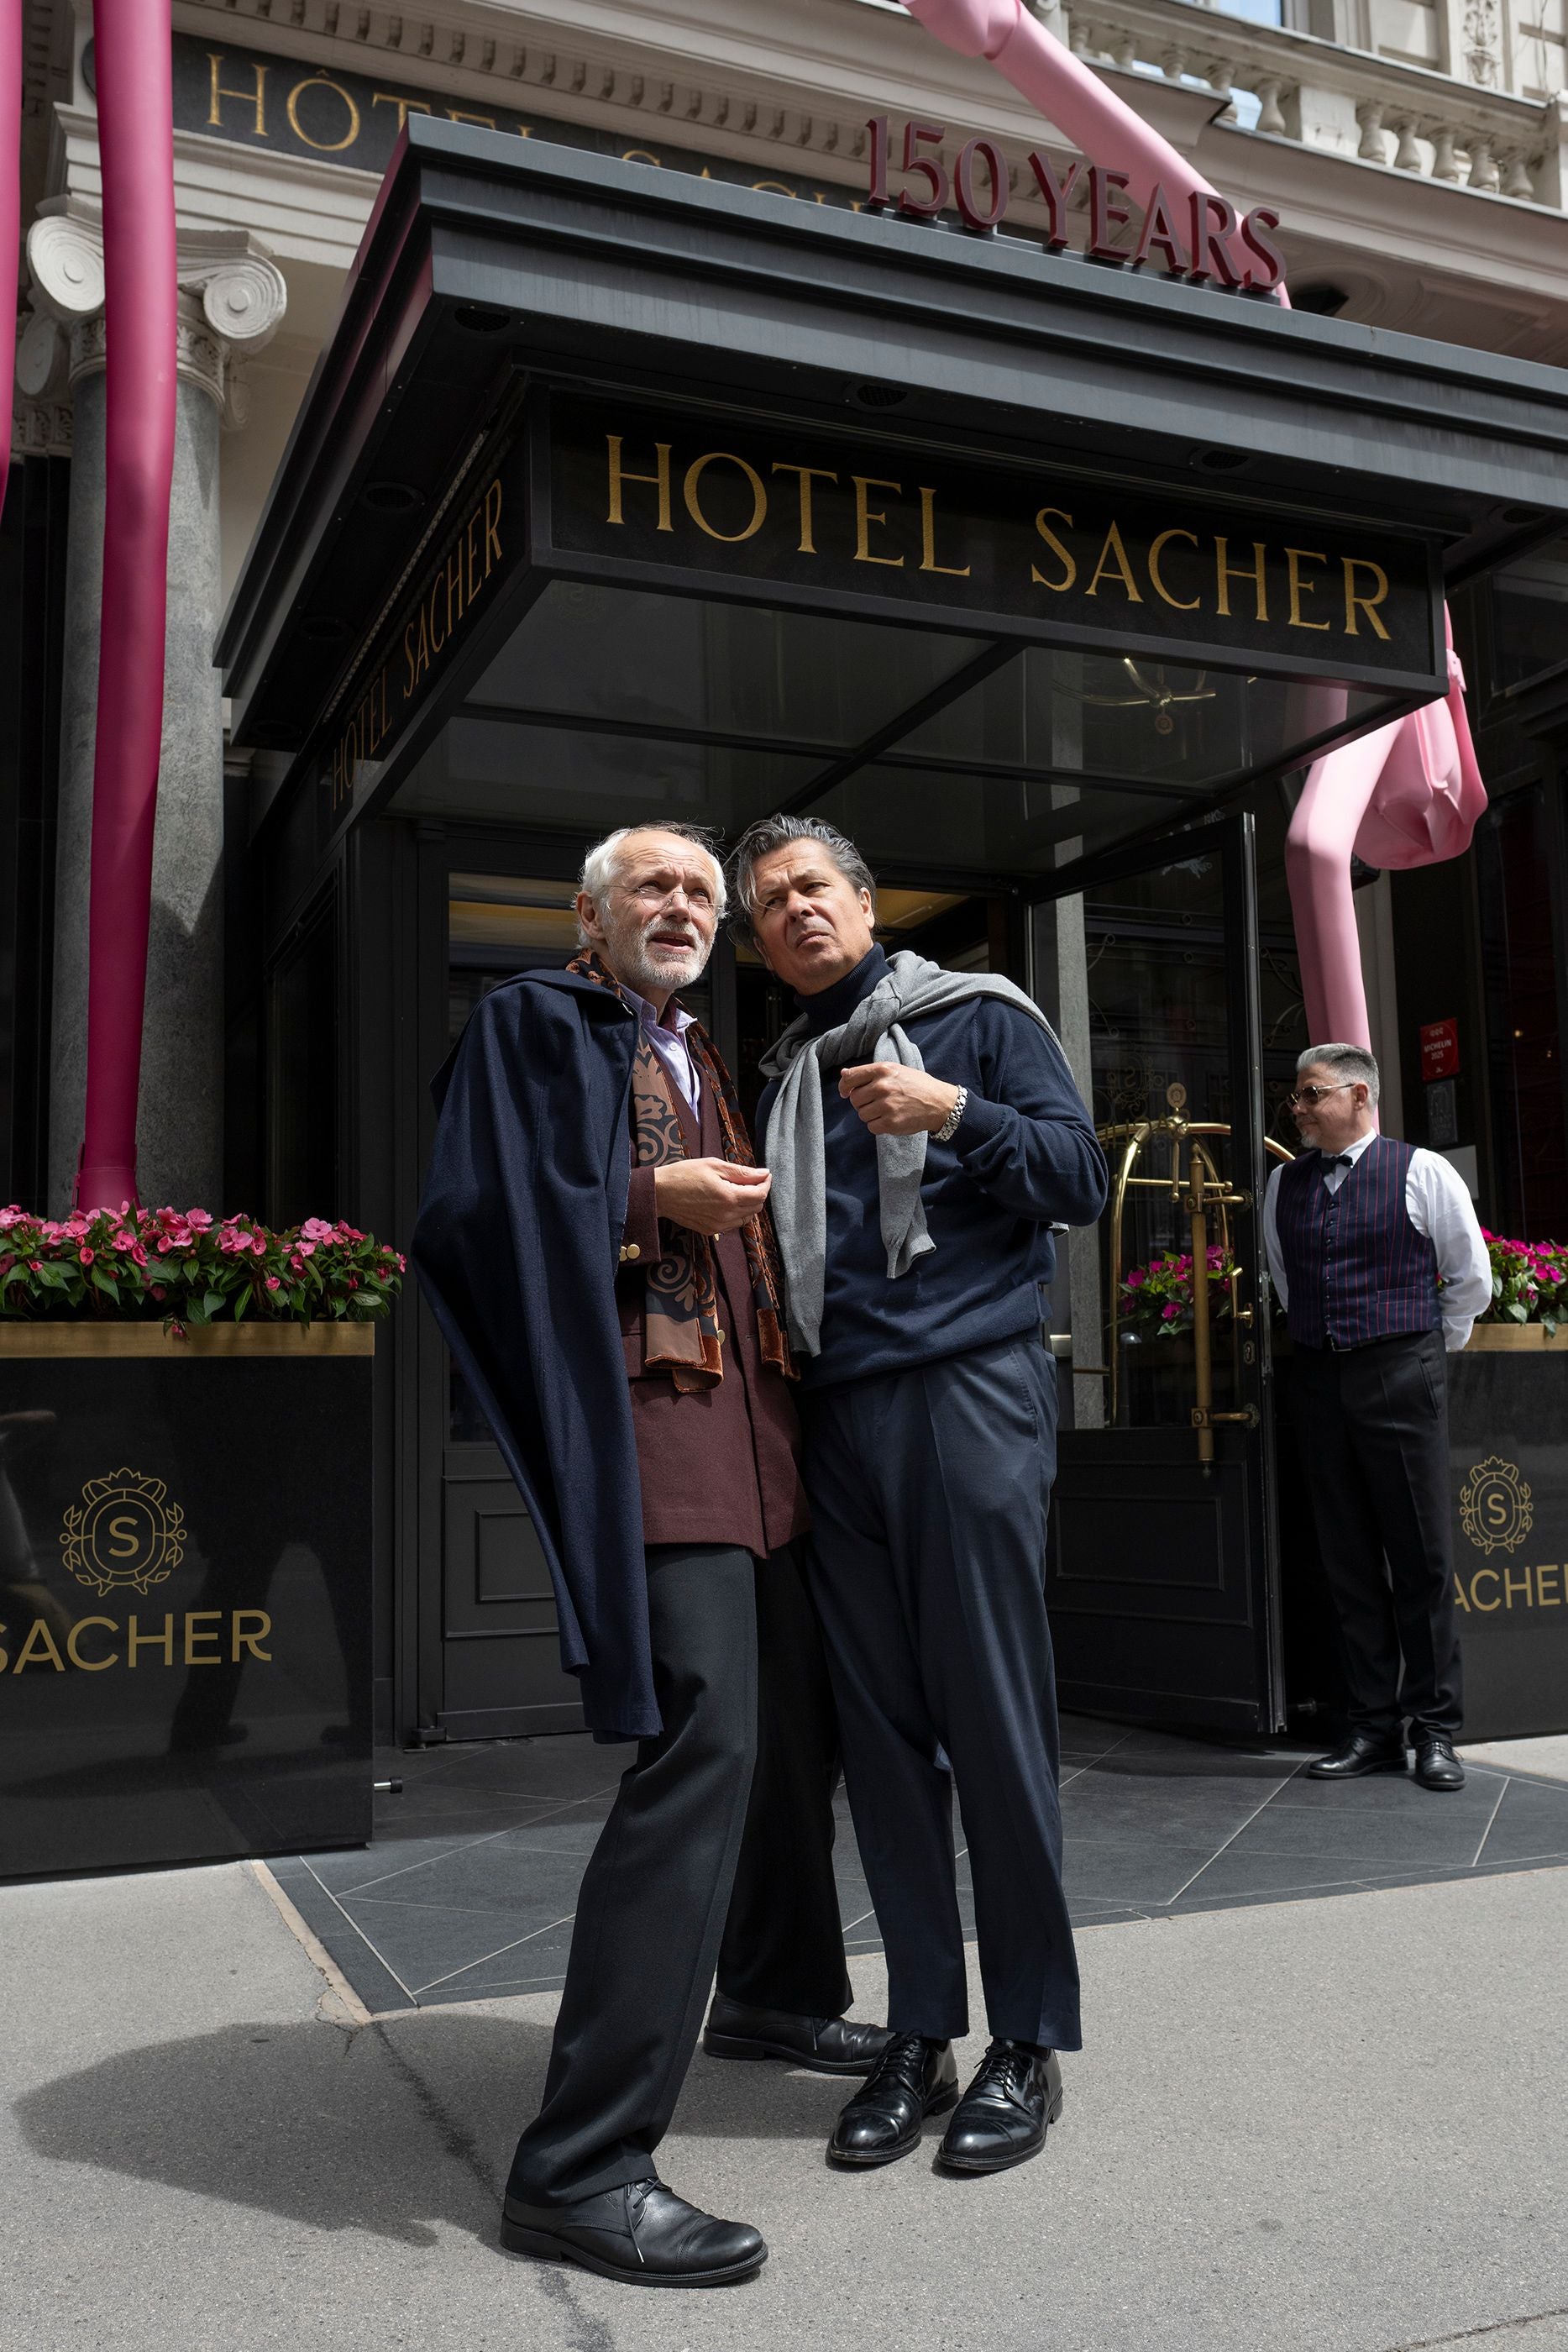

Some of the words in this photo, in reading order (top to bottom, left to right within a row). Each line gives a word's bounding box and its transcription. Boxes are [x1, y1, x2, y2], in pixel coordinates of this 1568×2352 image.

[207, 53, 534, 151] HÔT
[865, 114, 1007, 232] 150
[1027, 151, 1287, 293] YEARS
[606, 434, 971, 577] HOTEL
[1030, 507, 1392, 640] SACHER
[333, 666, 394, 811] HOTEL
[403, 478, 504, 700] SACHER
[1424, 1039, 1452, 1053] MICHELIN
[108, 1516, 139, 1557] S
[1487, 1493, 1507, 1525] S
[1454, 1563, 1568, 1613] ACHE
[0, 1609, 273, 1675] ACHER
